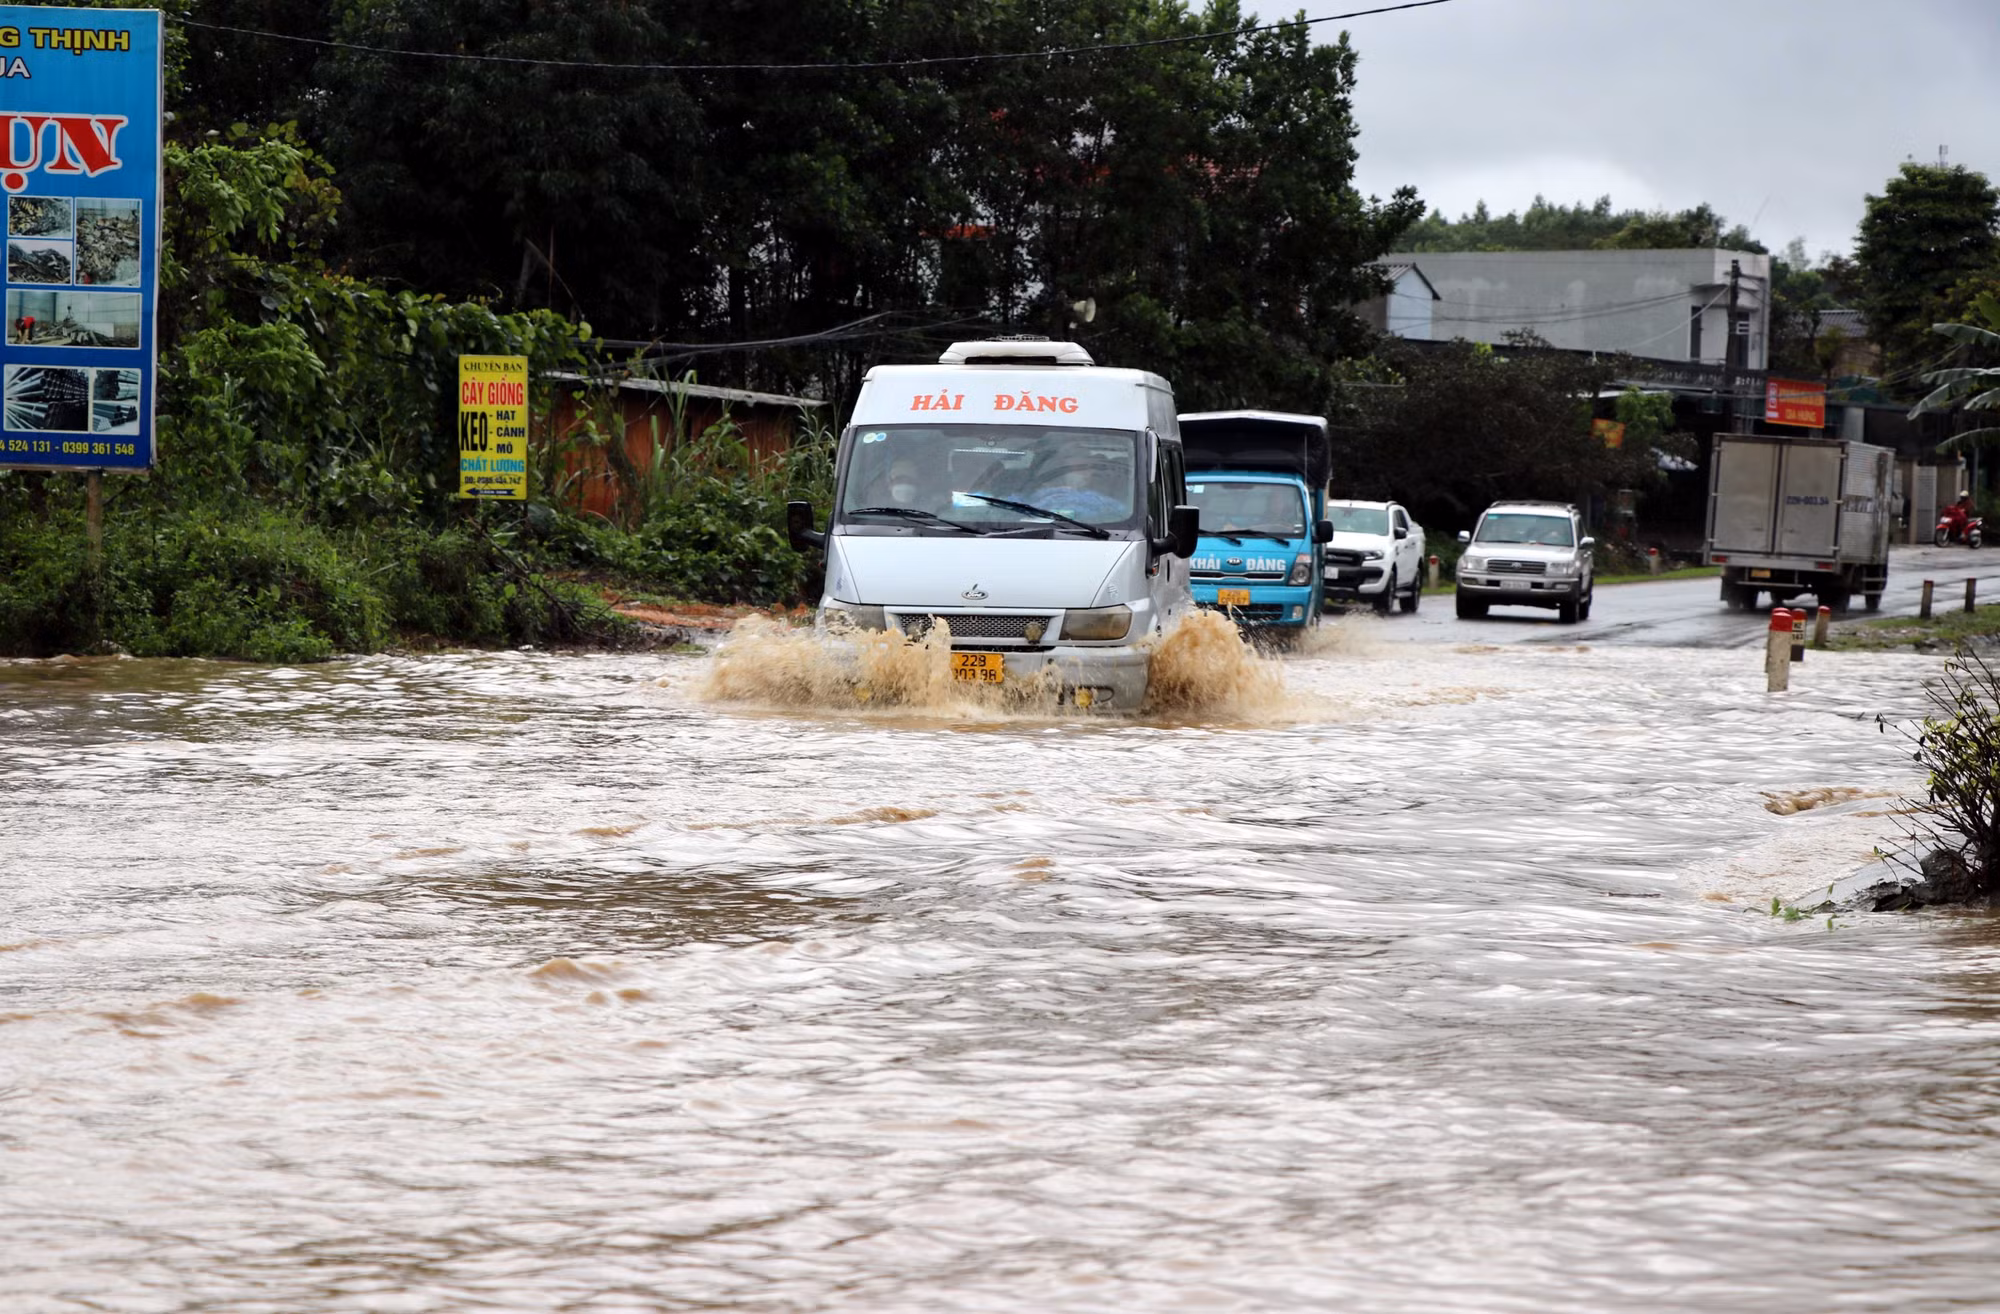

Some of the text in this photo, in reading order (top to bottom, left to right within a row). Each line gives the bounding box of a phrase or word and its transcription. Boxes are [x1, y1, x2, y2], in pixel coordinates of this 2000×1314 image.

[28, 27, 130, 55] THỊNH
[462, 373, 524, 406] CÂY GIỐNG
[910, 388, 1079, 413] HẢI ĐĂNG
[461, 411, 488, 452] KEO
[8, 439, 29, 452] 524
[32, 440, 51, 452] 131
[62, 441, 89, 454] 0399
[92, 442, 110, 454] 361
[115, 443, 135, 455] 548
